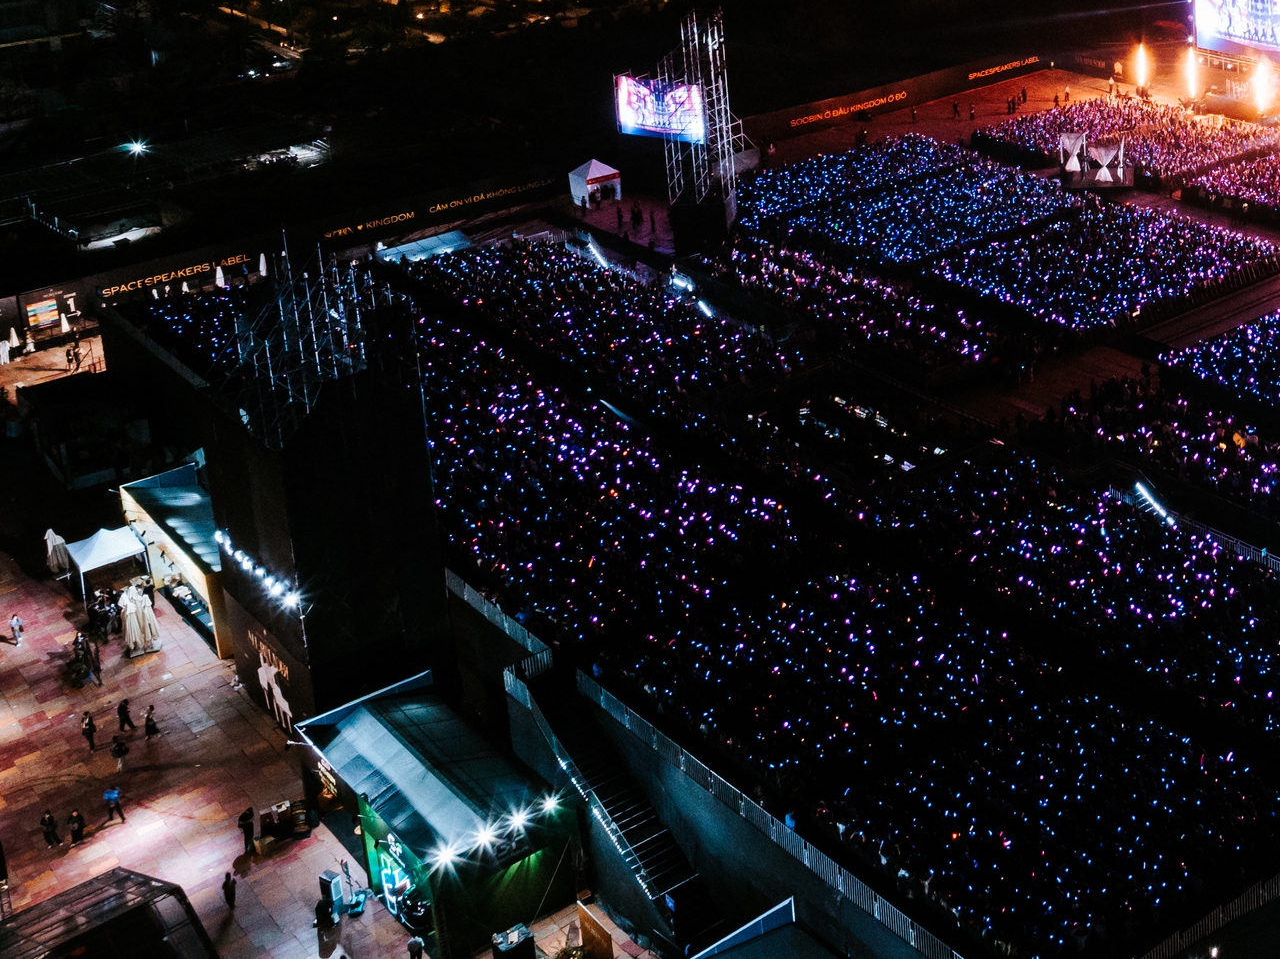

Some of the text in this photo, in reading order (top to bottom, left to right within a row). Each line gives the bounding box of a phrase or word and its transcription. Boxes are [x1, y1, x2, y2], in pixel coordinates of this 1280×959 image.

[968, 55, 1040, 80] SPACESPEAKERS LABEL
[790, 113, 823, 128] SOOBIN
[850, 97, 887, 113] KINGDOM
[486, 186, 517, 200] KHÔNG
[365, 211, 415, 230] KINGDOM
[212, 254, 251, 269] LABEL
